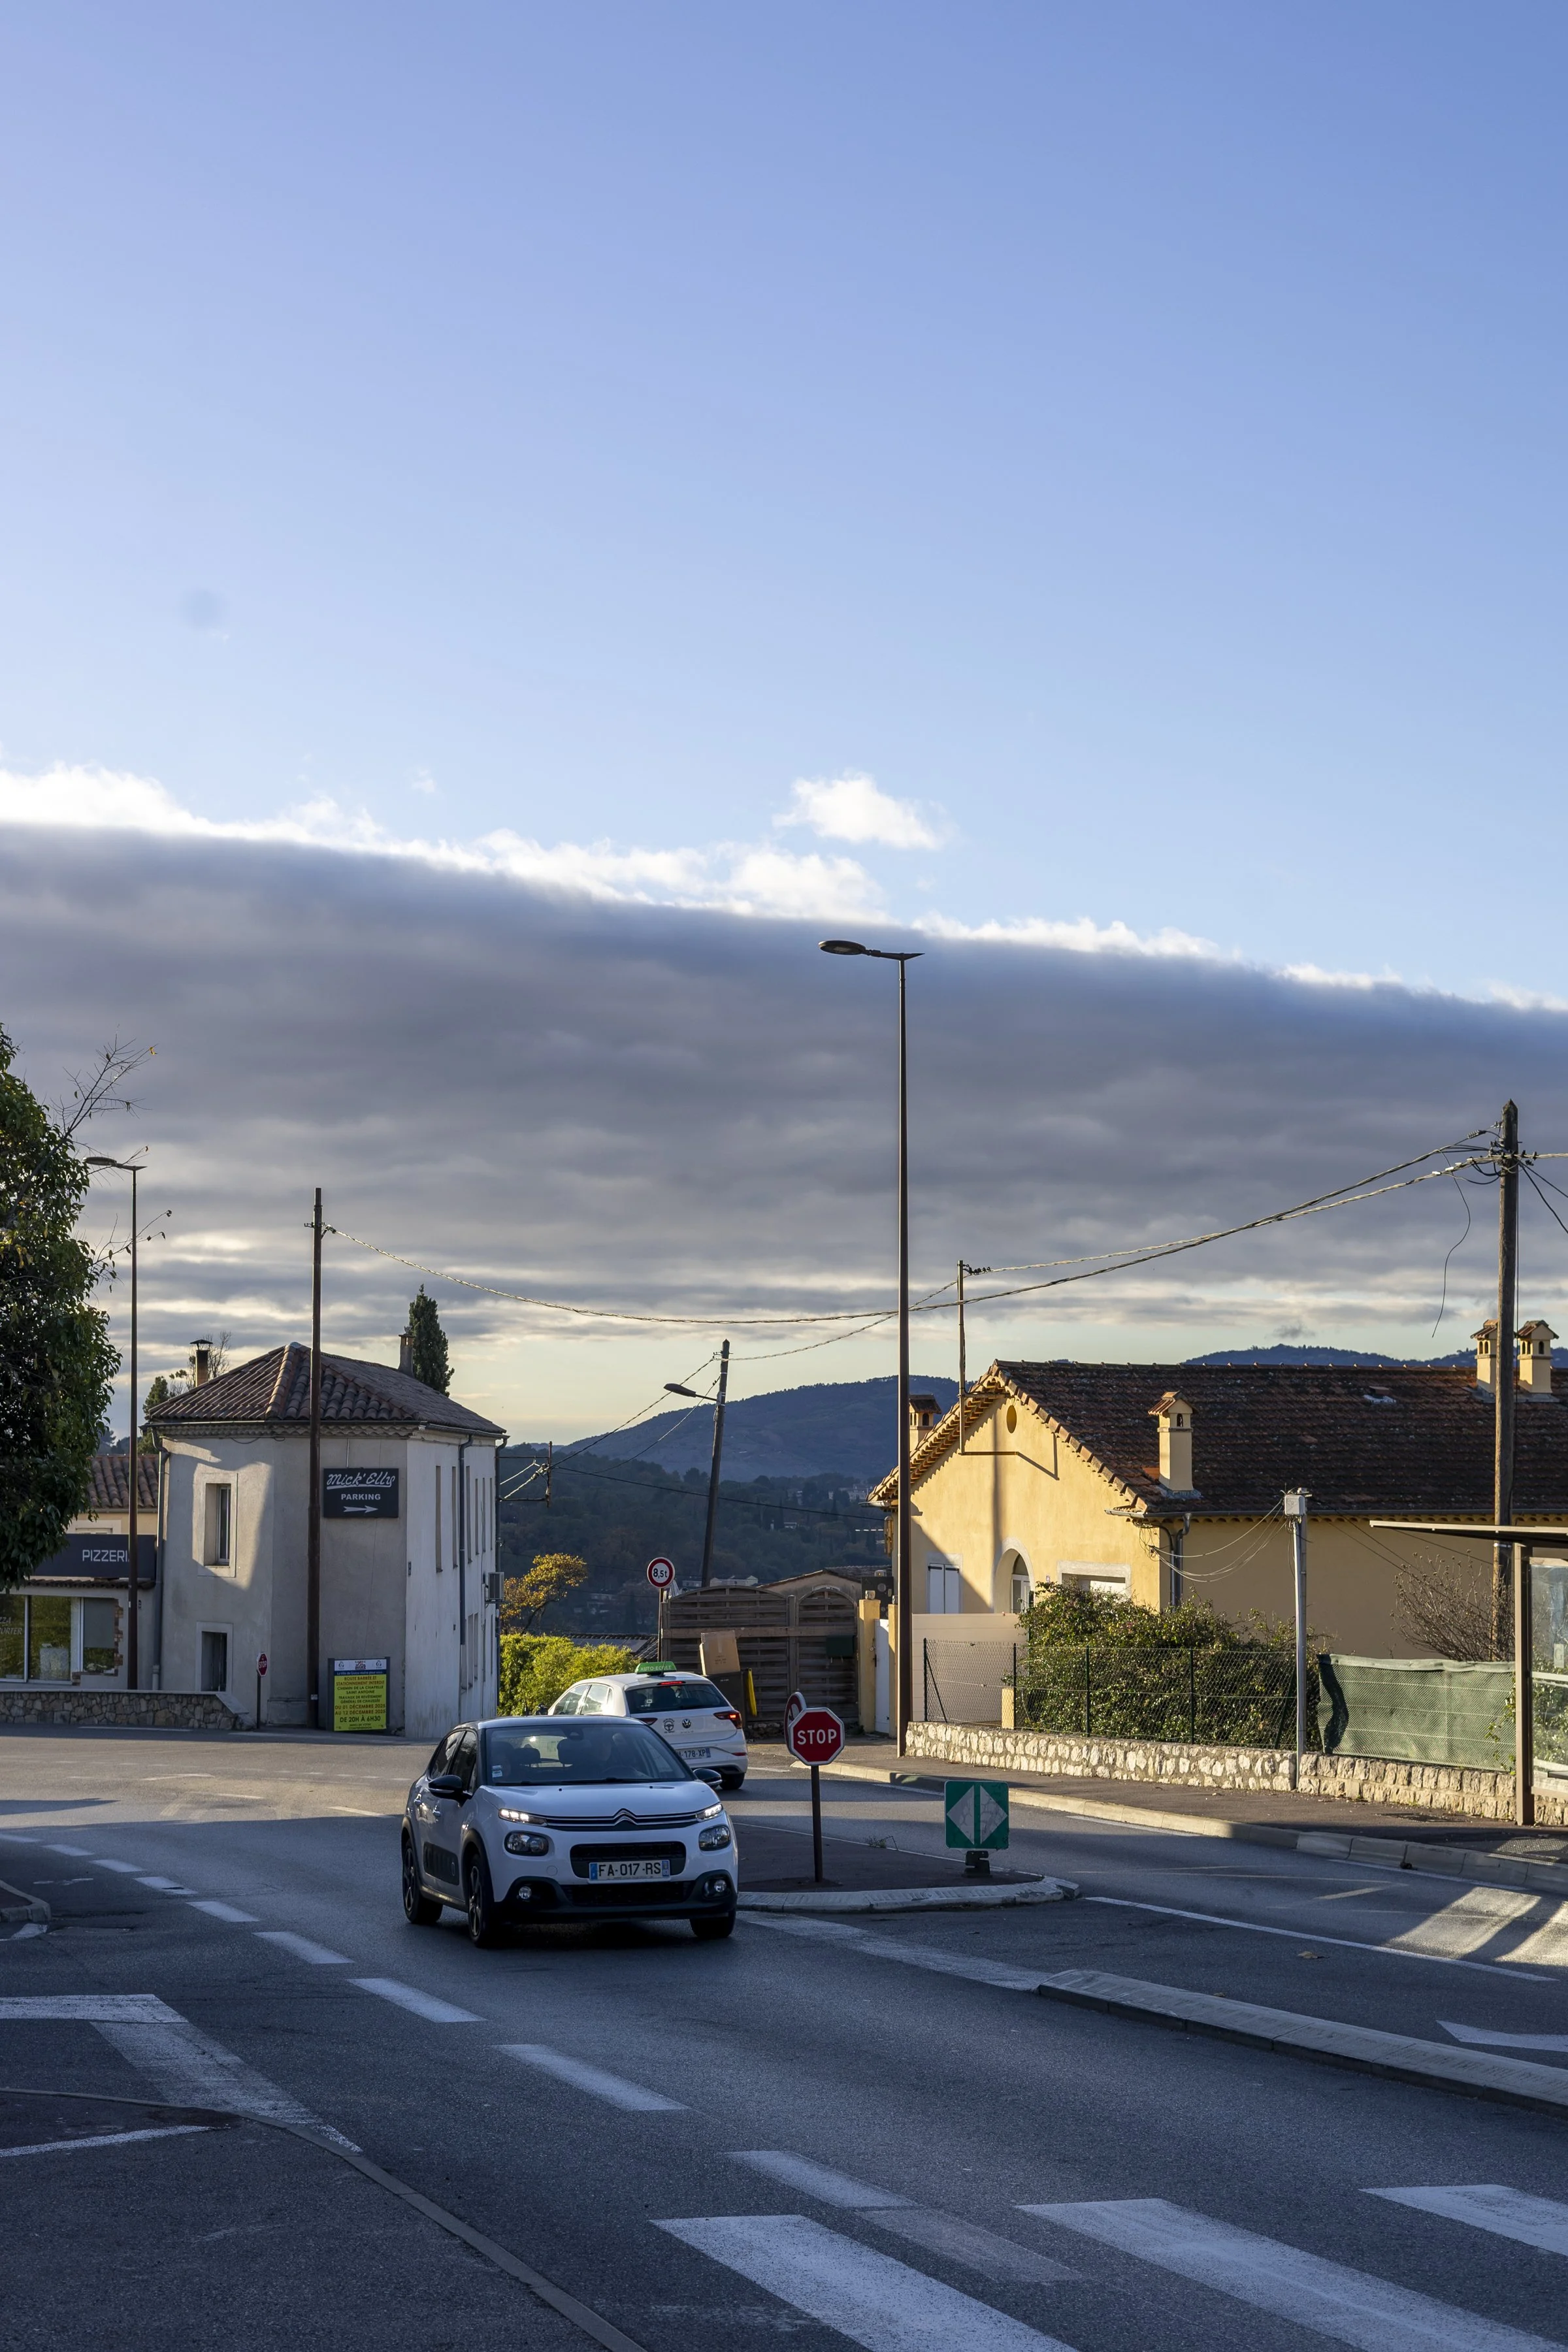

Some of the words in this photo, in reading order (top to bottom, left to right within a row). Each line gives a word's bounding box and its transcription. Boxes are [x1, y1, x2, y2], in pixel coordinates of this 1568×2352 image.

[82, 1549, 129, 1562] PIZZERI
[653, 1568, 668, 1579] 8,5t
[797, 1729, 837, 1745] STOP
[598, 1862, 661, 1876] FA-017-RS
